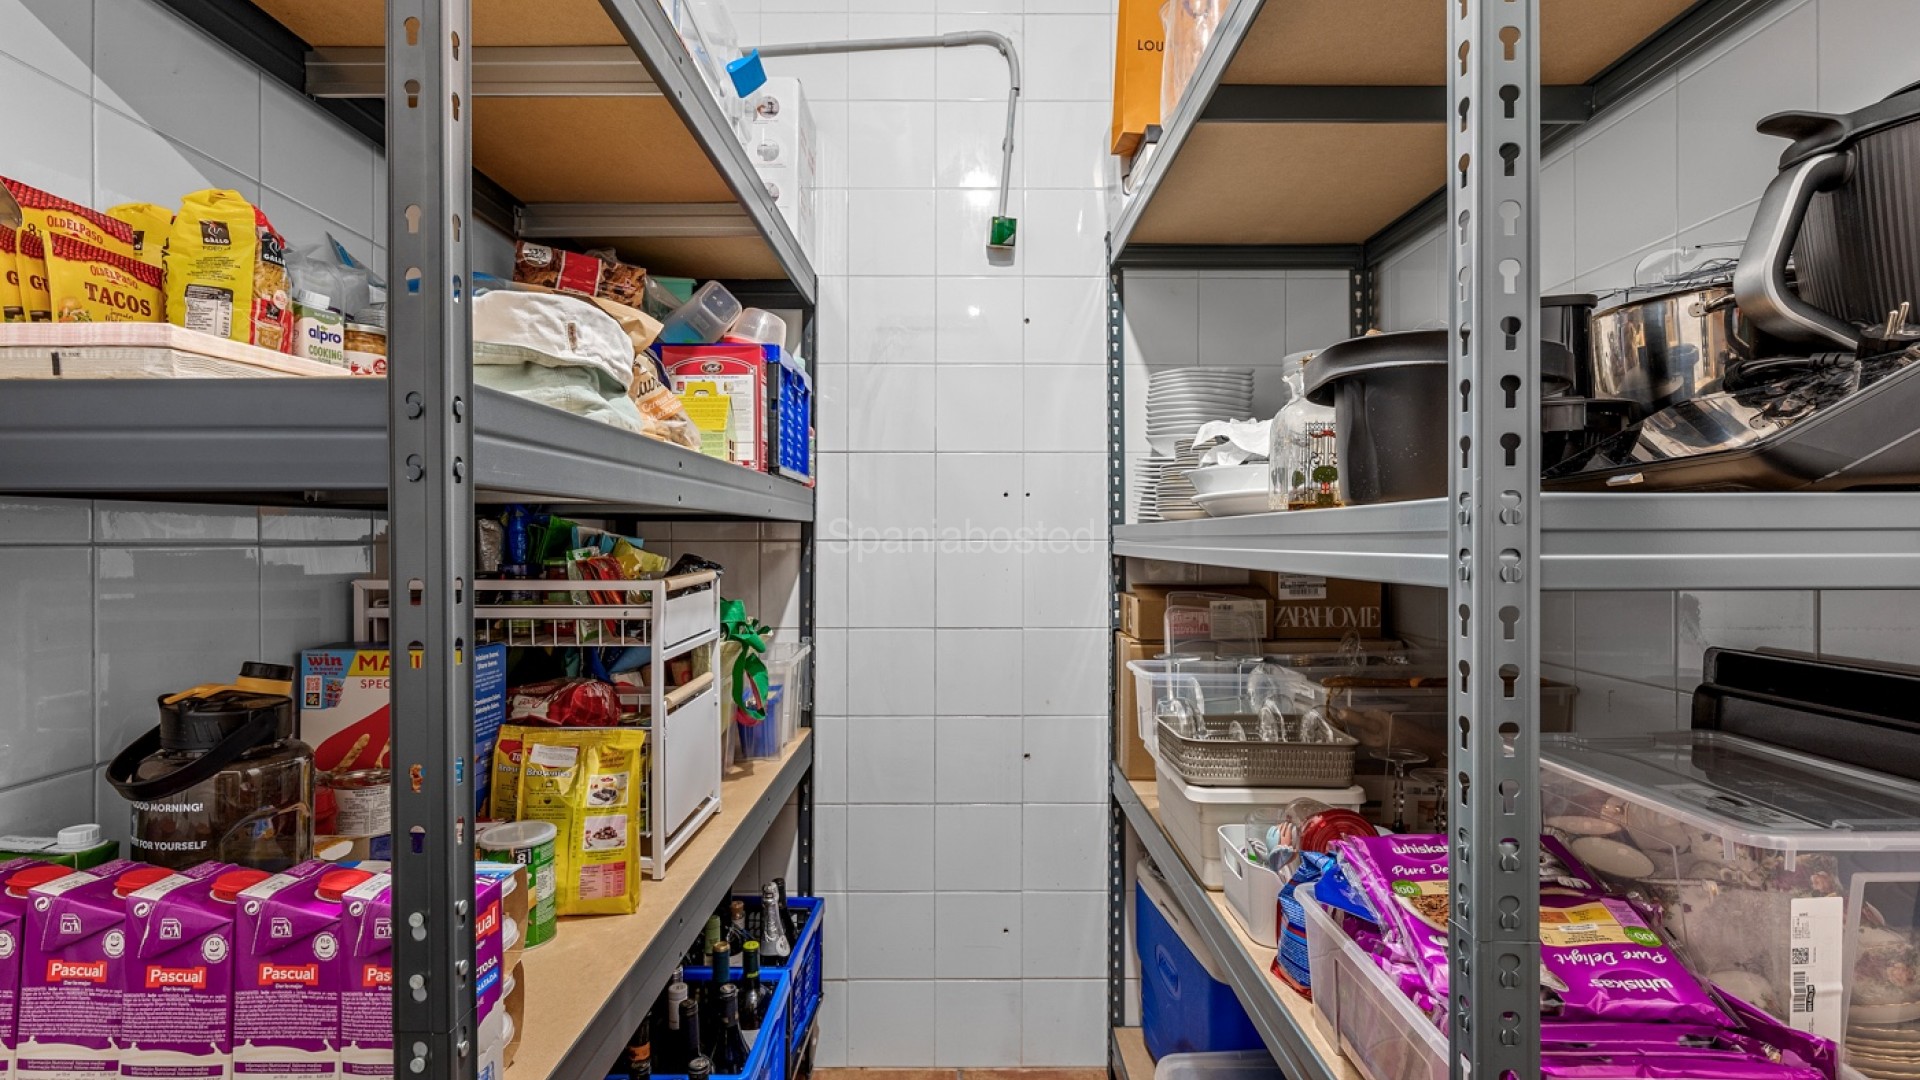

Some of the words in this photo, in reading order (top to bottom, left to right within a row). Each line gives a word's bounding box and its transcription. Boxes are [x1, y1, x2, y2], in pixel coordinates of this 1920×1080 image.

[84, 281, 152, 317] TACOS
[308, 324, 342, 344] alpro
[307, 653, 343, 666] win
[150, 803, 204, 812] MORNING!
[154, 840, 208, 851] YOURSELF
[1392, 864, 1427, 876] Pure
[1553, 948, 1618, 967] Delight
[1620, 950, 1668, 964] Pure
[50, 962, 104, 977] Pascual
[150, 968, 203, 983] Pascual
[262, 966, 315, 980] Pascual
[367, 967, 392, 982] Pas
[1589, 977, 1674, 993] whiskas
